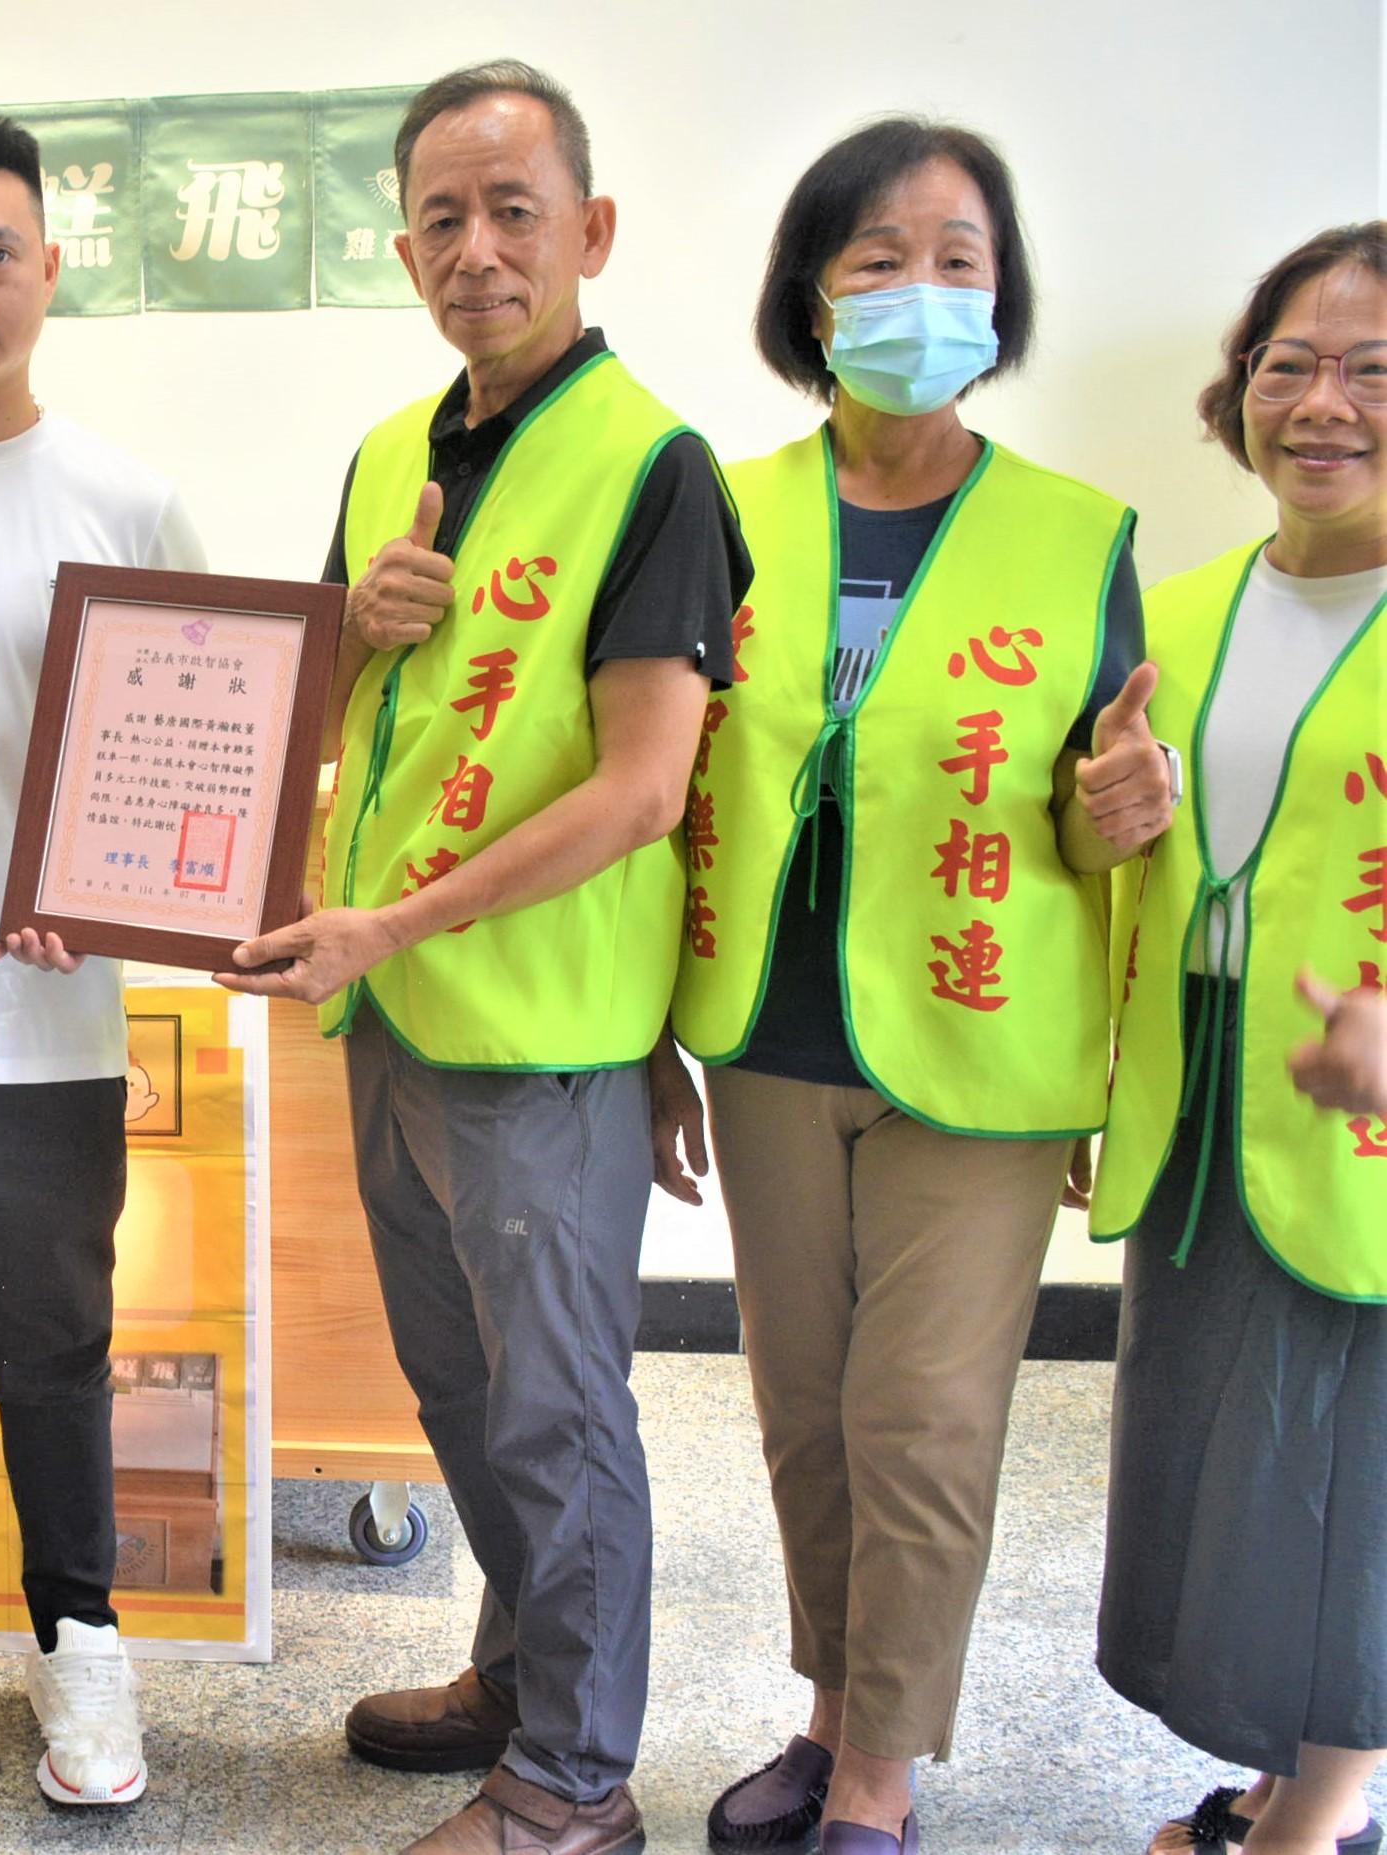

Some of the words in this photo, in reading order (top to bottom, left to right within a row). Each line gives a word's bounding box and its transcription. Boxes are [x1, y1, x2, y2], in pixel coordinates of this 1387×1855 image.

[126, 666, 247, 695] 感謝狀
[927, 625, 1044, 1012] 心手相連
[103, 851, 149, 870] 理事長
